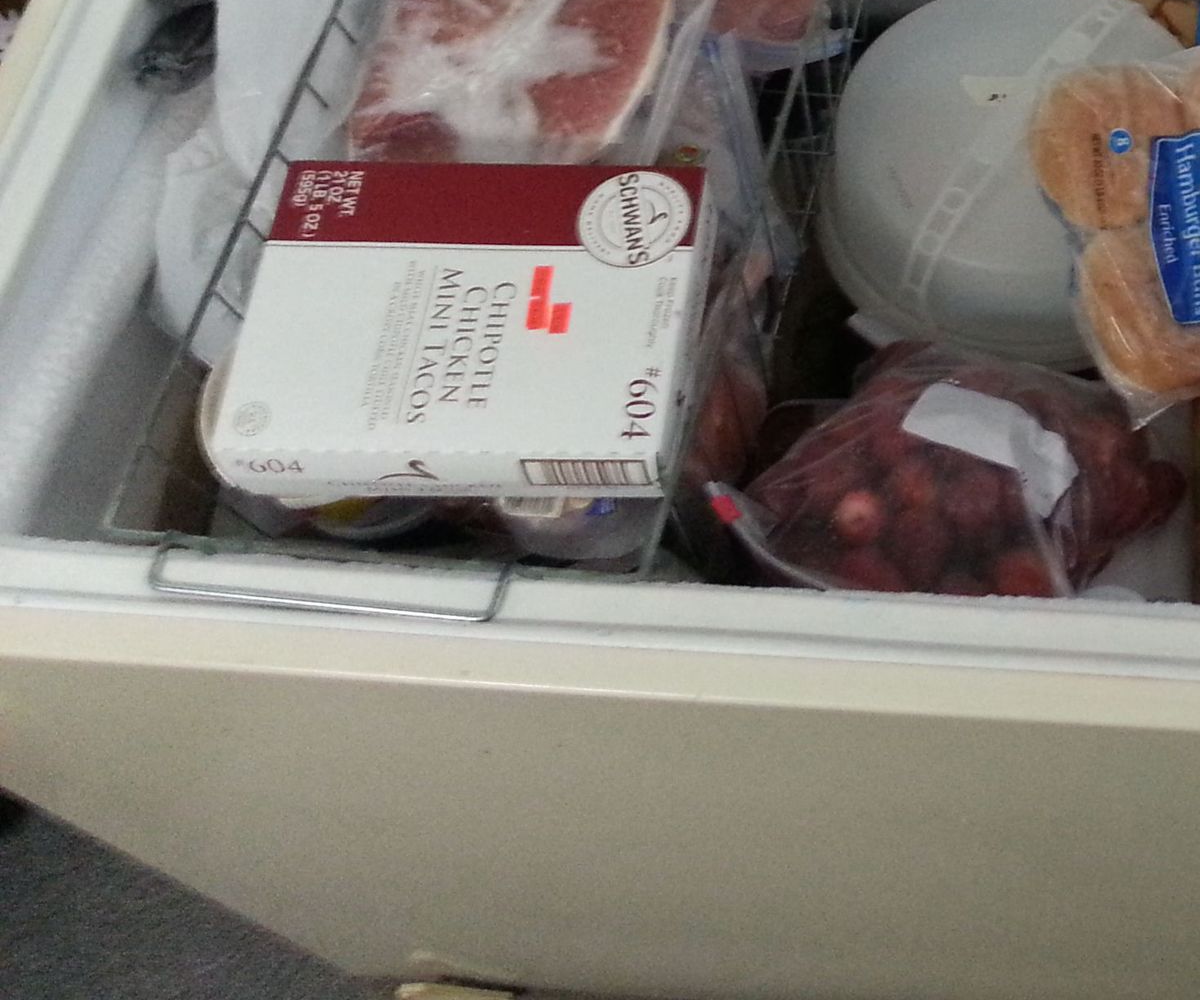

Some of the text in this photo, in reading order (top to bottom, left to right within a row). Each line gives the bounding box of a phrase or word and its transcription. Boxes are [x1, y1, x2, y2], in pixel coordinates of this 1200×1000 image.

[332, 170, 349, 184] 21
[346, 170, 365, 194] NET
[618, 173, 650, 265] SCHWAN'S
[1157, 203, 1180, 264] Enriched
[406, 268, 464, 424] MINI TACOS
[438, 286, 488, 402] CHICKEN
[467, 282, 518, 409] CHIPOTLE
[621, 366, 662, 441] #604
